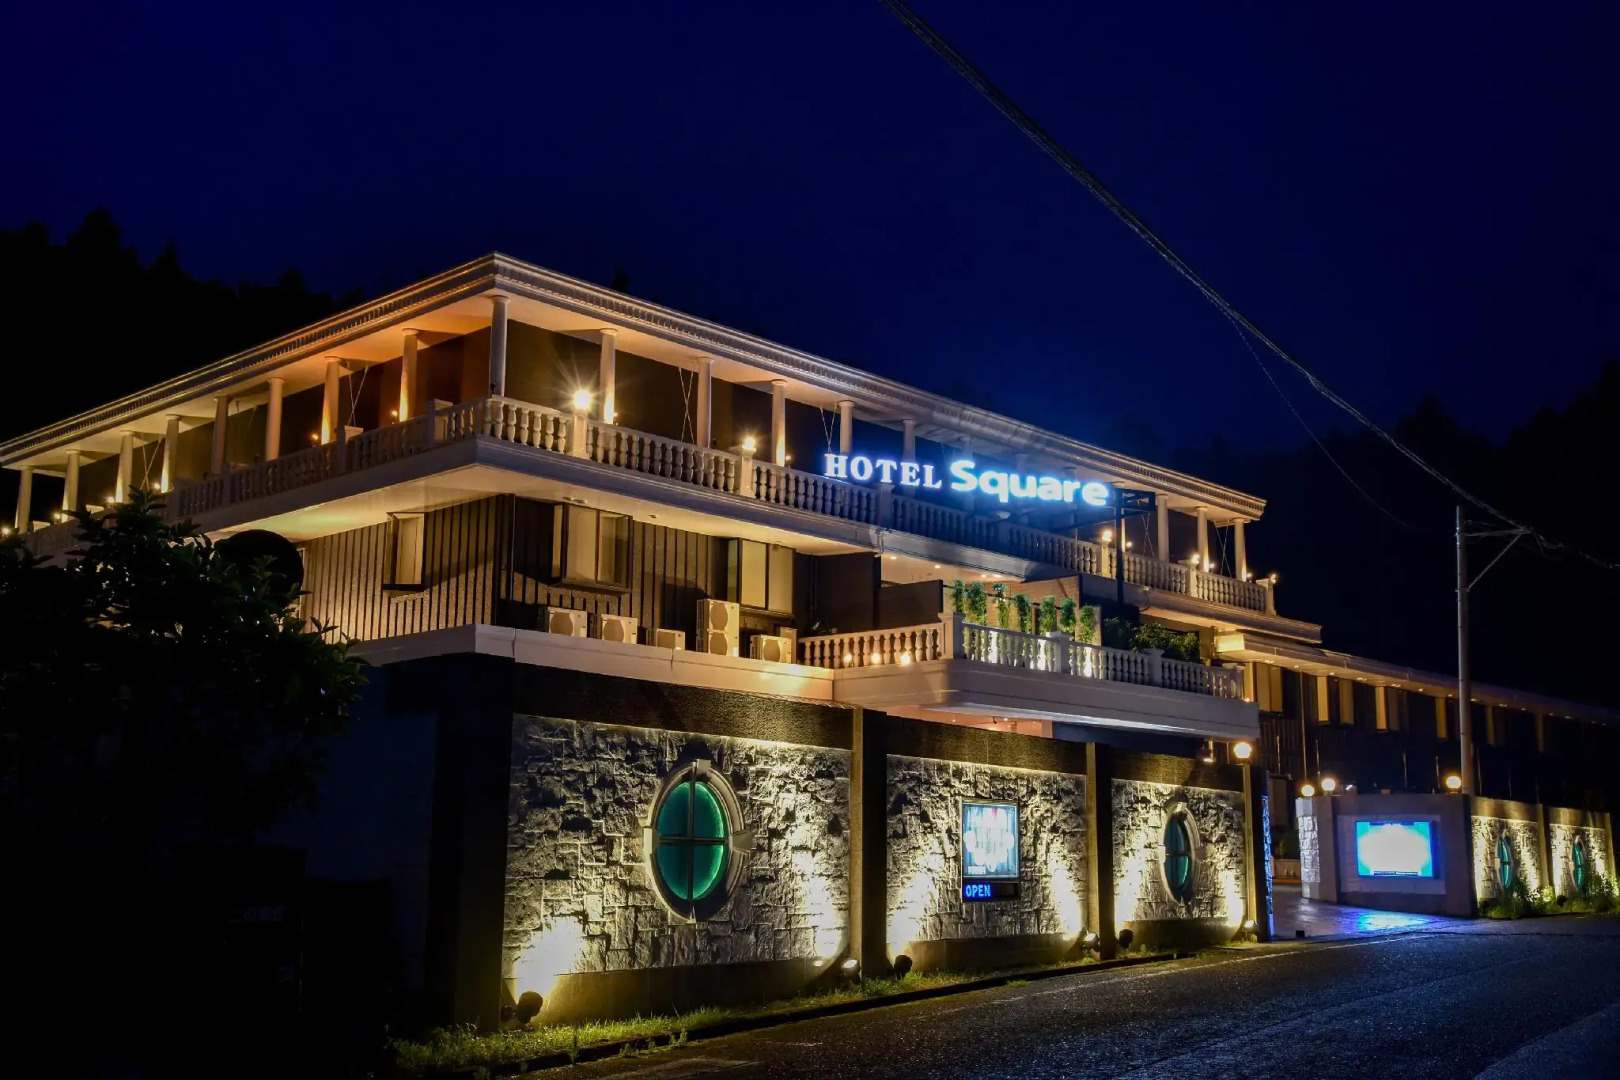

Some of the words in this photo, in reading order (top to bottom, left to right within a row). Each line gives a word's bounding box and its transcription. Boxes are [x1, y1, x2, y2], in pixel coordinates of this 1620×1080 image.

[824, 453, 942, 489] HOTEL
[950, 459, 1109, 506] Square
[965, 884, 991, 898] OPEN
